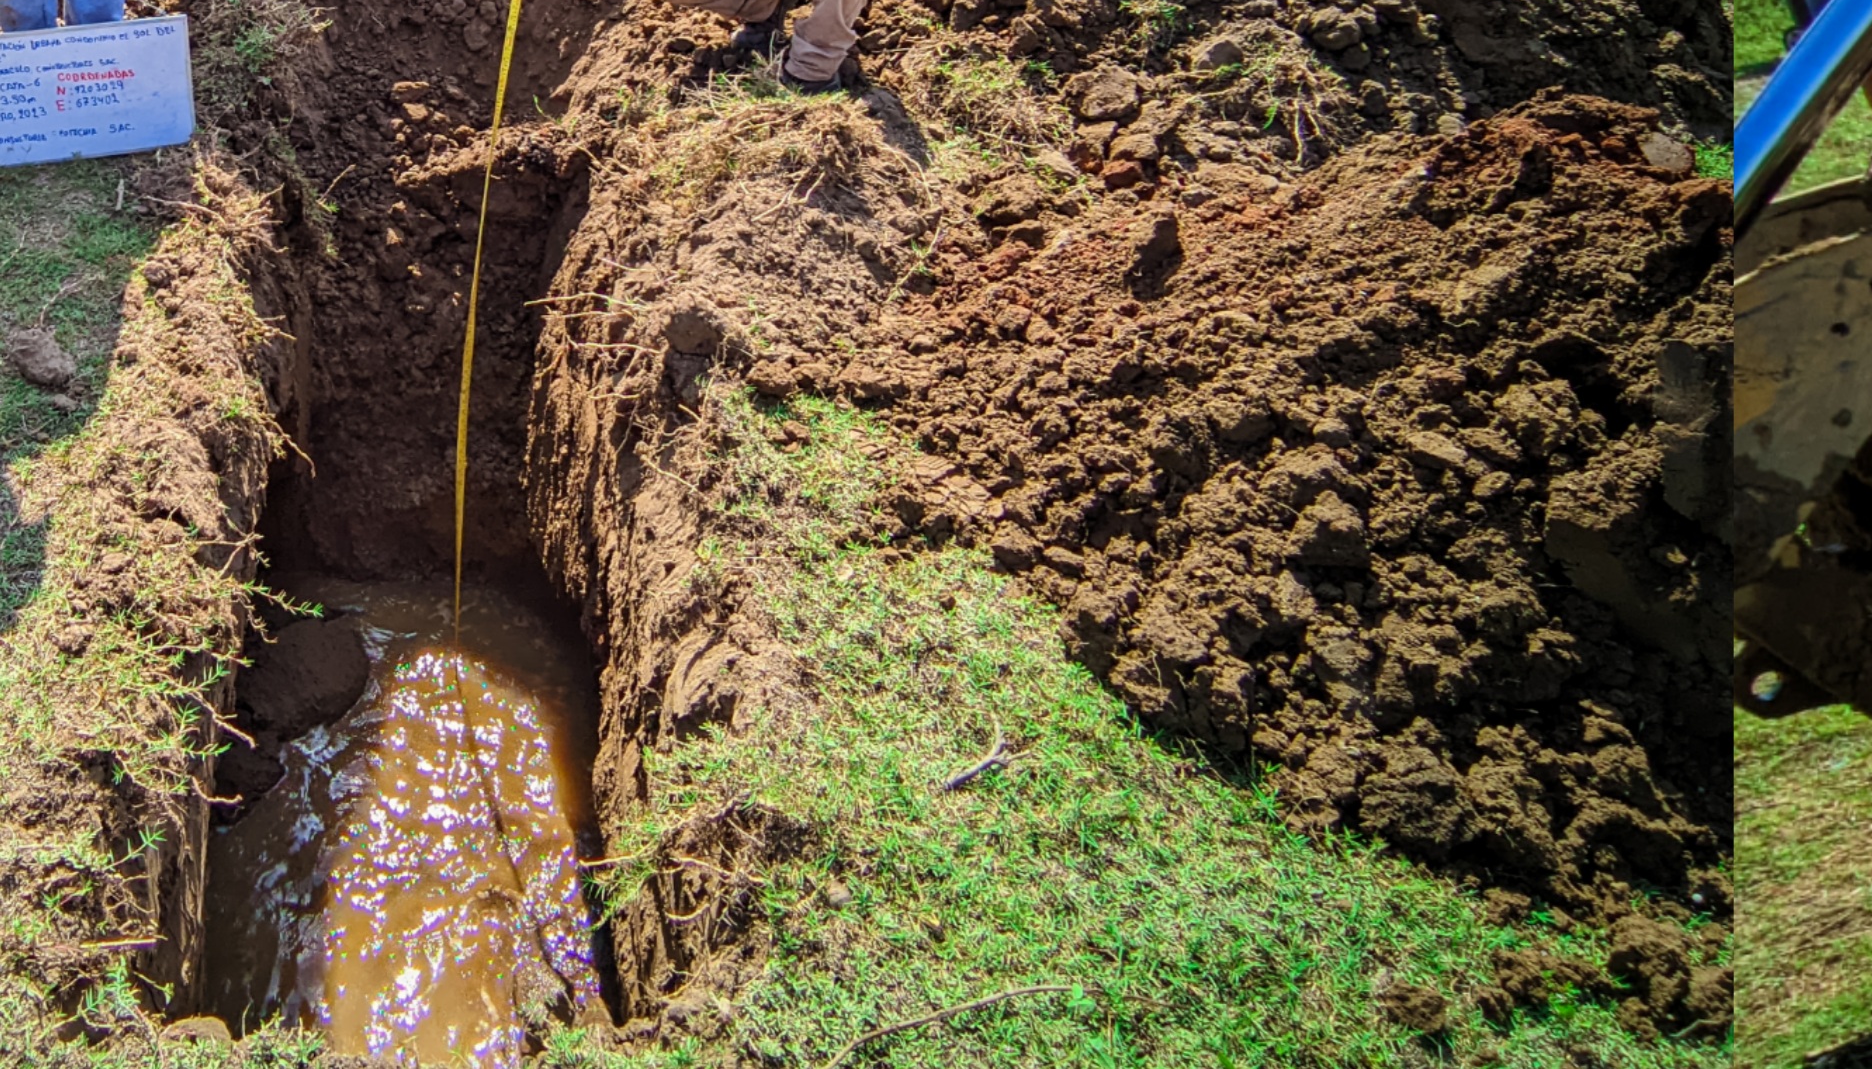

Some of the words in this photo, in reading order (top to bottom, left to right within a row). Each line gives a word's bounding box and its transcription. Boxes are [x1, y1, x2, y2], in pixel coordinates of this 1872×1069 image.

[133, 28, 151, 39] SOL
[156, 25, 176, 36] DEL
[57, 68, 135, 82] COORDENADAS
[0, 78, 41, 92] CATA-6
[18, 106, 47, 119] 2023
